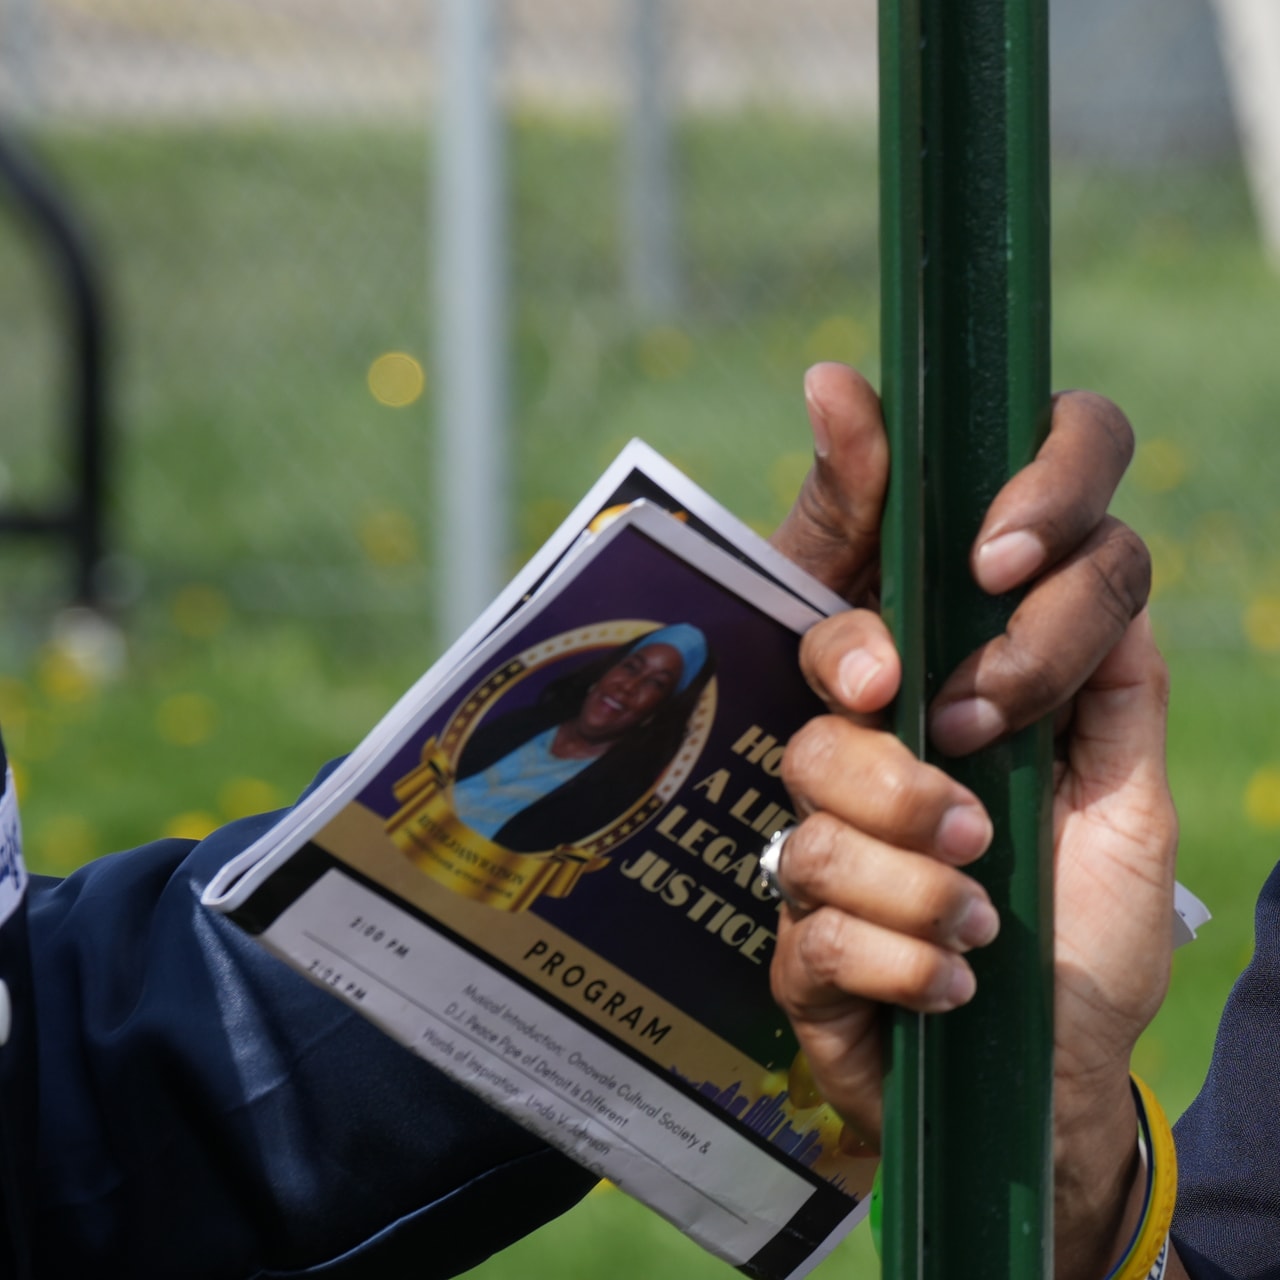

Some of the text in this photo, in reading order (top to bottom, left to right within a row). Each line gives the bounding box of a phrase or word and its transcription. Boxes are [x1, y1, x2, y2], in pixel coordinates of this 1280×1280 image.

[692, 768, 731, 804] A
[385, 937, 410, 958] PM
[620, 850, 778, 965] JUSTICE
[344, 981, 367, 1000] PM
[523, 939, 672, 1045] PROGRAM
[454, 1050, 471, 1063] of
[525, 1094, 556, 1120] Linda
[567, 1124, 610, 1155] Johnson
[462, 983, 507, 1014] Musical
[567, 1051, 617, 1090] Omowale
[616, 1084, 663, 1118] Cultural
[658, 1112, 701, 1149] Society
[699, 1141, 712, 1155] &
[497, 1035, 522, 1058] Pipe
[521, 1054, 541, 1066] of
[534, 1060, 573, 1090] Detroit
[580, 1089, 629, 1127] Different
